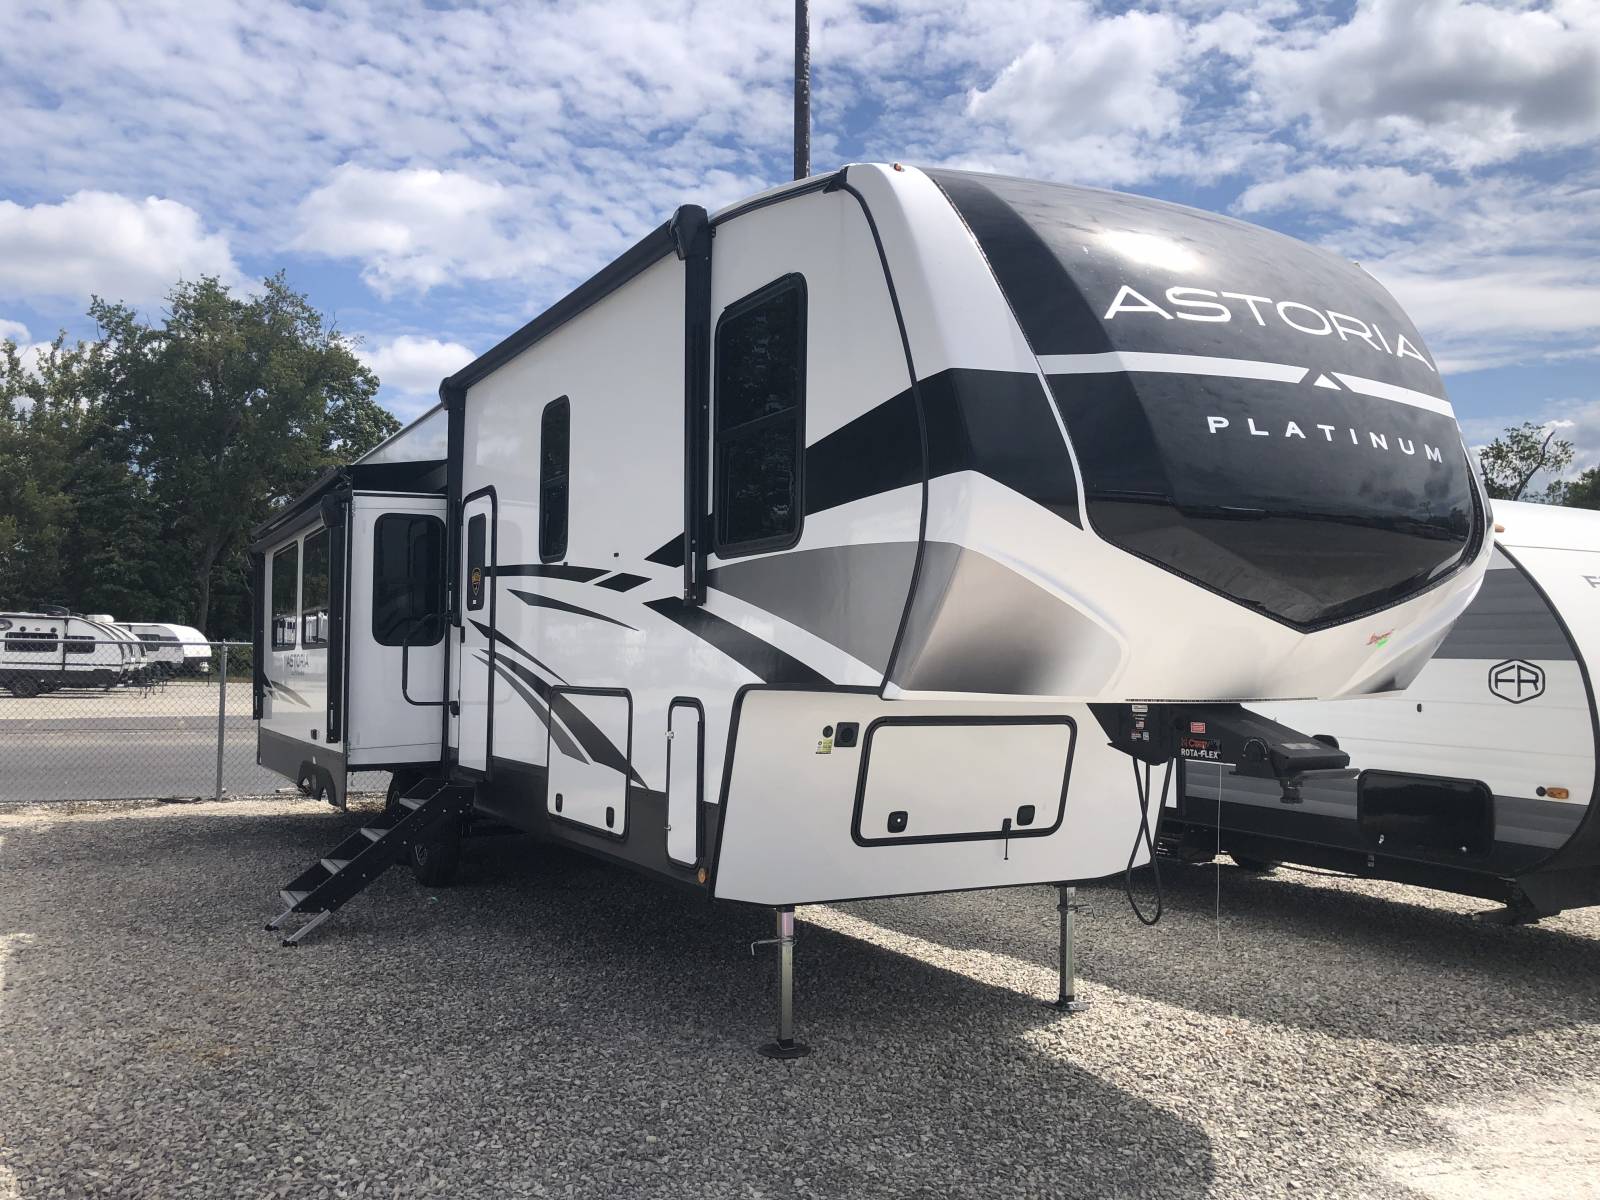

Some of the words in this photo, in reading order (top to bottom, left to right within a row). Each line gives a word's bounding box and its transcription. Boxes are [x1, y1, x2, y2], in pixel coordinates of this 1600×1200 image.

[1104, 285, 1436, 371] ASTORIA
[1207, 416, 1442, 464] PLATINUM
[1180, 748, 1219, 759] ROTA-FLEX
